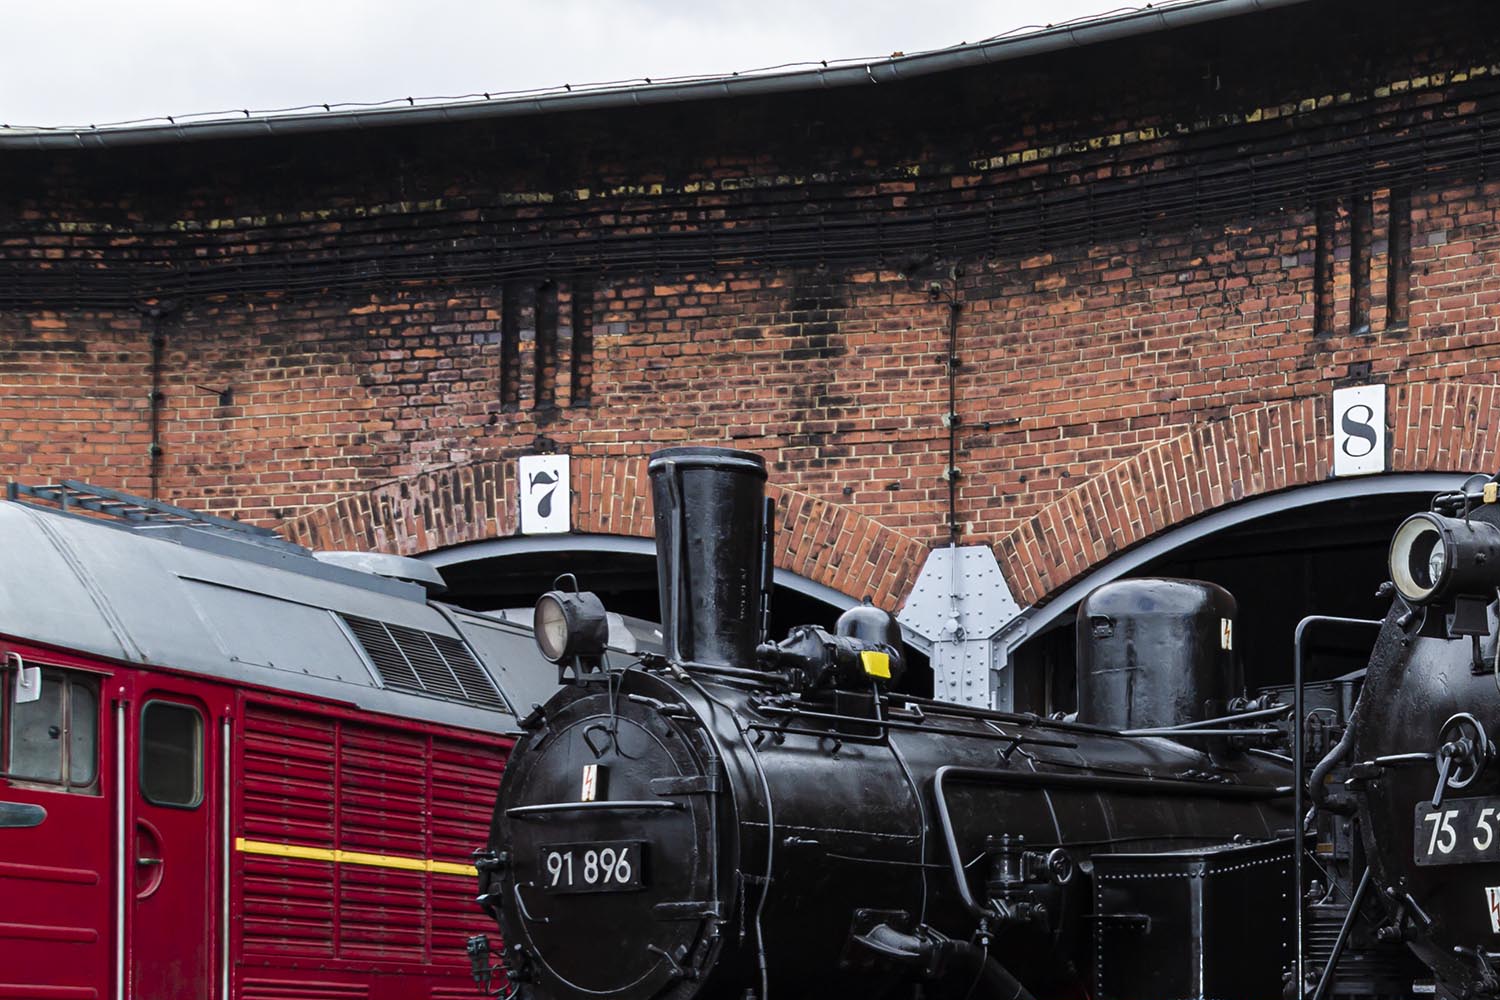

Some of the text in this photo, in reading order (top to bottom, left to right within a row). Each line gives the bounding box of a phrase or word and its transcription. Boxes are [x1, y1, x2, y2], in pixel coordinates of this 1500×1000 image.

[1341, 404, 1377, 458] 8
[528, 469, 560, 519] 7
[1424, 809, 1461, 857] 75
[546, 847, 632, 887] 91 896
